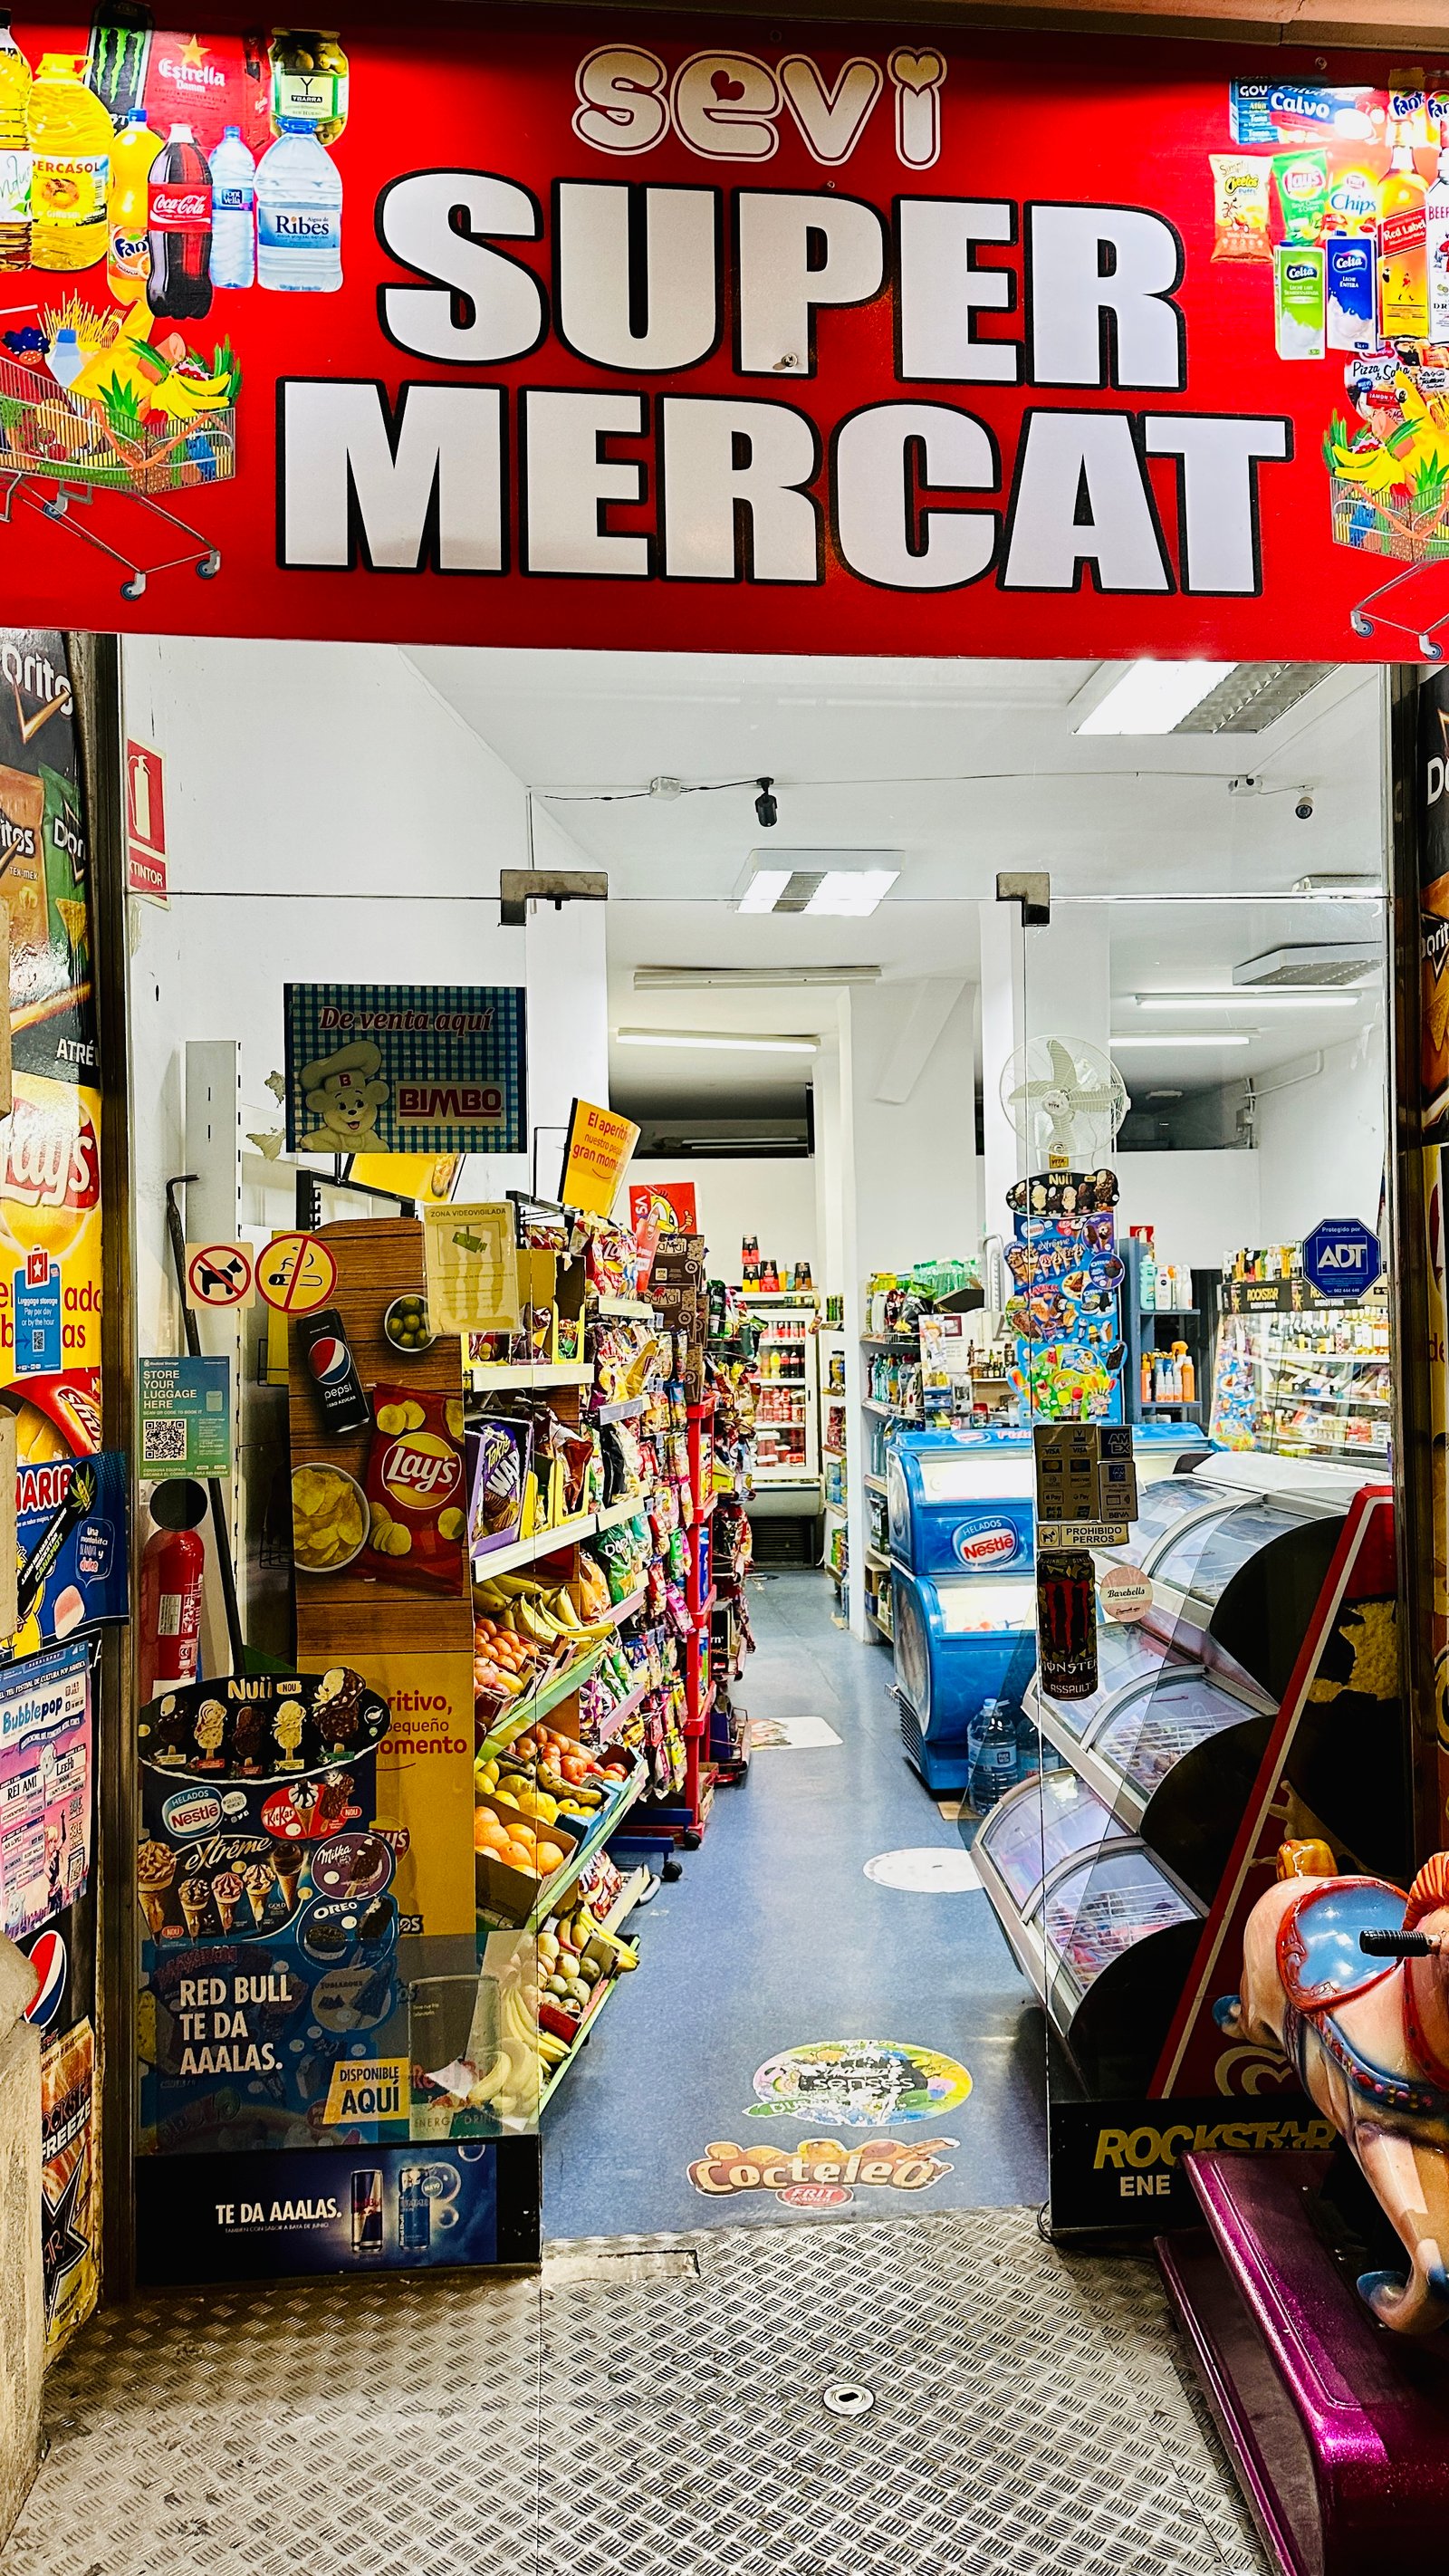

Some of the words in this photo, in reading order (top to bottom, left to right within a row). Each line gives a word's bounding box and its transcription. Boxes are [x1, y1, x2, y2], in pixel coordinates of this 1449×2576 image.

[158, 57, 226, 88] Estrella
[291, 95, 323, 103] YBARRA
[571, 43, 947, 170] sevi
[1270, 91, 1330, 119] Calvo
[152, 193, 206, 216] Coca-Cola
[1330, 193, 1377, 215] Chips
[274, 214, 330, 236] Ribes
[1288, 265, 1315, 277] Celta
[1336, 256, 1363, 270] Celta
[376, 169, 1185, 391] SUPER
[1352, 361, 1381, 378] Pizza
[277, 378, 1291, 595] MERCAT
[320, 1006, 353, 1031] De
[360, 1008, 429, 1033] venta
[435, 1007, 495, 1036] aquí
[399, 1088, 503, 1118] BIMBO
[587, 1111, 599, 1129] El
[584, 1134, 609, 1150] nuestro
[572, 1144, 596, 1162] gran
[430, 1210, 451, 1218] ZONA
[1318, 1244, 1367, 1268] ADT
[17, 1296, 39, 1306] Luggage
[39, 1296, 59, 1306] storage
[142, 1370, 180, 1379] STORE
[143, 1379, 174, 1389] YOUR
[323, 1381, 353, 1402] pepsi
[142, 1389, 197, 1399] LUGGAGE
[143, 1399, 173, 1409] HERE
[1108, 1433, 1129, 1445] AM
[387, 1446, 456, 1495] Lay's
[962, 1519, 1003, 1537] HELADOS
[1065, 1526, 1123, 1536] PROHIBIDO
[1072, 1534, 1115, 1543] PERROS
[1107, 1586, 1146, 1599] Barebells
[282, 1682, 297, 1693] NOU
[3, 1696, 63, 1735] Bubblepop
[171, 1789, 210, 1808] HELADOS
[266, 1807, 295, 1825] KitKat
[344, 1808, 360, 1816] NOU
[317, 1845, 351, 1866] Milka
[312, 1900, 359, 1920] OREO
[166, 1927, 180, 1936] NOU
[180, 1978, 226, 2008] RED
[235, 1974, 293, 2004] BULL
[179, 2013, 206, 2042] TE
[214, 2010, 249, 2039] DA
[179, 2043, 283, 2076] AAALAS.
[339, 2066, 399, 2082] DISPONIBLE
[812, 2076, 916, 2091] senses
[341, 2080, 400, 2116] AQUÍ
[791, 2187, 838, 2199] FRIT
[1118, 2175, 1172, 2196] ENE
[216, 2204, 235, 2225] TE
[240, 2201, 264, 2224] DA
[269, 2197, 342, 2223] AAALAS.
